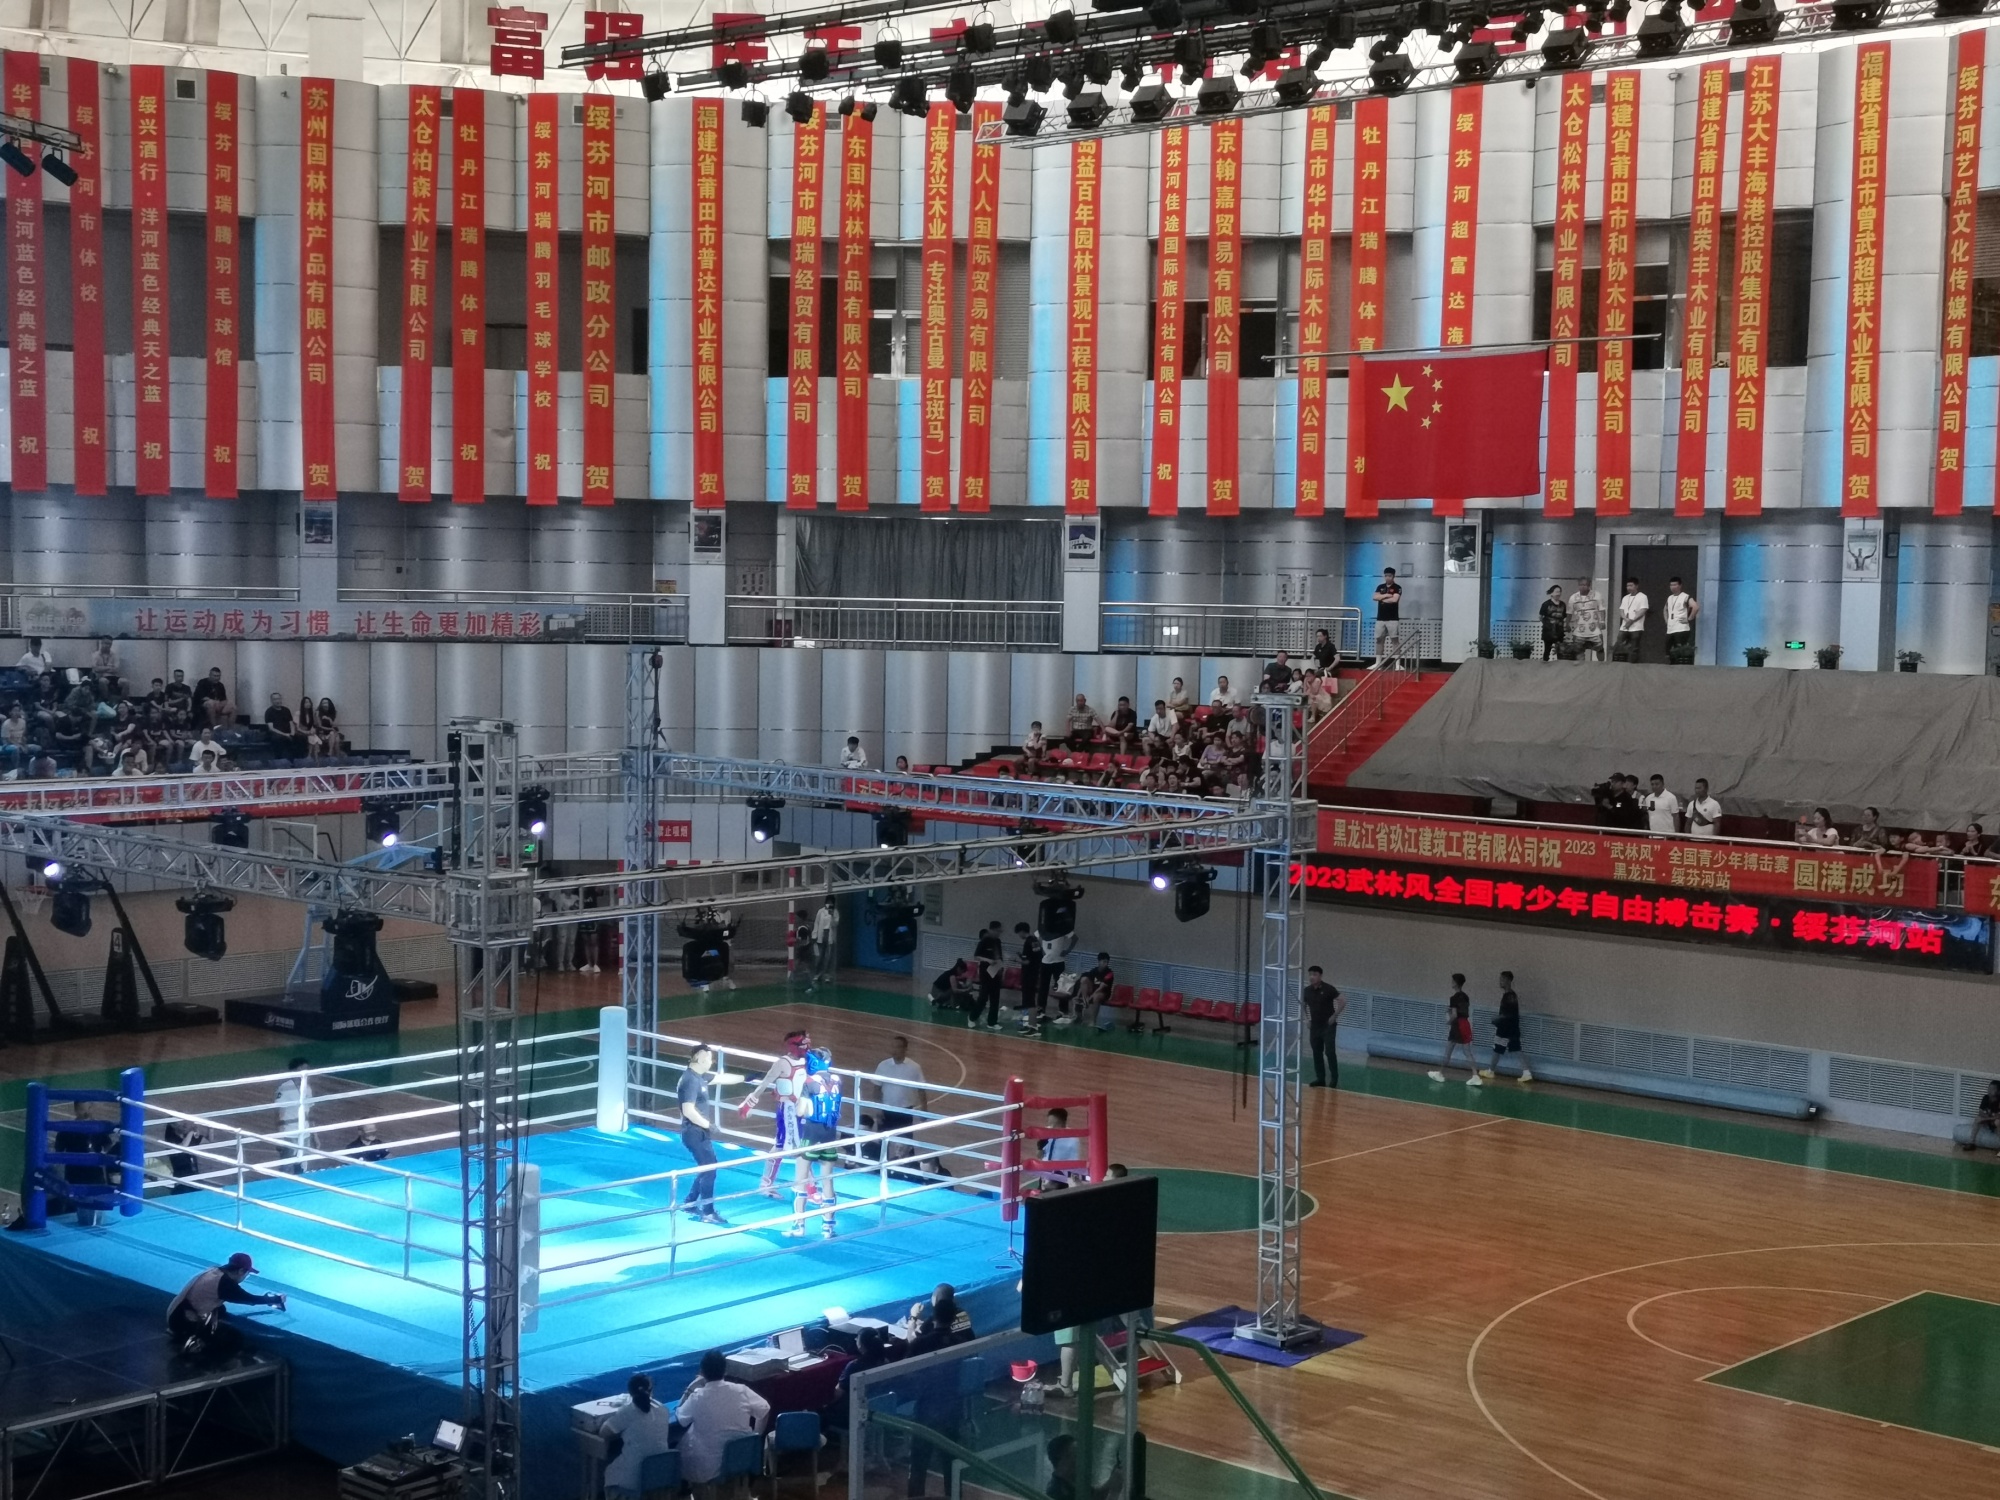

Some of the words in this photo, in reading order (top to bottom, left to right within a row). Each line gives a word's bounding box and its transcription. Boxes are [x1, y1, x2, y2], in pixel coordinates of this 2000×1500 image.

[76, 106, 97, 302] 绥芬河市体校
[214, 102, 231, 365] 绥芬河瑞腾羽毛球馆
[308, 88, 329, 385] 苏州国林林产品有限公司
[409, 95, 433, 361] 太仓柏森木业有限公司
[461, 125, 477, 345] 牡丹江瑞腾体育
[1448, 113, 1474, 344] 绥芬河超富达海
[1555, 83, 1585, 366] 太仓松林木业有限公司
[12, 84, 37, 397] 华·洋河蓝色经典海之蓝
[1355, 126, 1381, 350] 牡丹江瑞腾体育
[1736, 65, 1774, 430] 江苏大丰海港控股集团有限公司
[1942, 65, 1979, 433] 绥芬河艺点文化传媒有限公司
[587, 105, 609, 407] 绥芬河市邮政分公司
[1605, 77, 1634, 433] 福建省莆田市和协木业有限公司
[1684, 69, 1723, 432] 福建省莆田市荣丰木业有限公司
[1850, 51, 1884, 457] 福建省莆田市曾武超群木业有限公司
[534, 122, 550, 407] 绥芬河瑞腾羽毛球学校
[698, 106, 718, 432] 福建省莆田市普达木业有限公司
[1158, 129, 1182, 426] 绥芬河佳途国际旅行社有限公司
[19, 436, 38, 454] 祝
[82, 427, 100, 445] 祝
[143, 442, 162, 460] 祝
[214, 446, 230, 463] 祝
[461, 444, 477, 460] 祝
[534, 454, 550, 470] 祝
[1940, 447, 1959, 471] 贺
[309, 464, 329, 486] 贺
[405, 466, 423, 488] 贺
[587, 465, 609, 489] 贺
[699, 473, 718, 494] 贺
[1157, 463, 1172, 480] 祝
[791, 474, 810, 495] 贺
[842, 475, 861, 496] 贺
[925, 476, 944, 497] 贺
[965, 477, 983, 498] 贺
[1071, 478, 1090, 500] 贺
[1213, 479, 1233, 501] 贺
[1300, 479, 1319, 501] 贺
[1549, 479, 1570, 501] 贺
[1603, 477, 1624, 500] 贺
[1680, 477, 1699, 501] 贺
[1733, 476, 1755, 500] 贺
[1849, 474, 1870, 499] 贺
[135, 607, 330, 635] 让运动成为习惯
[354, 610, 541, 637] 让生命更加精彩
[1564, 839, 1596, 855] 2023
[1668, 846, 1790, 874] 全国青少年搏击赛
[1793, 859, 1905, 898] 圆满成功
